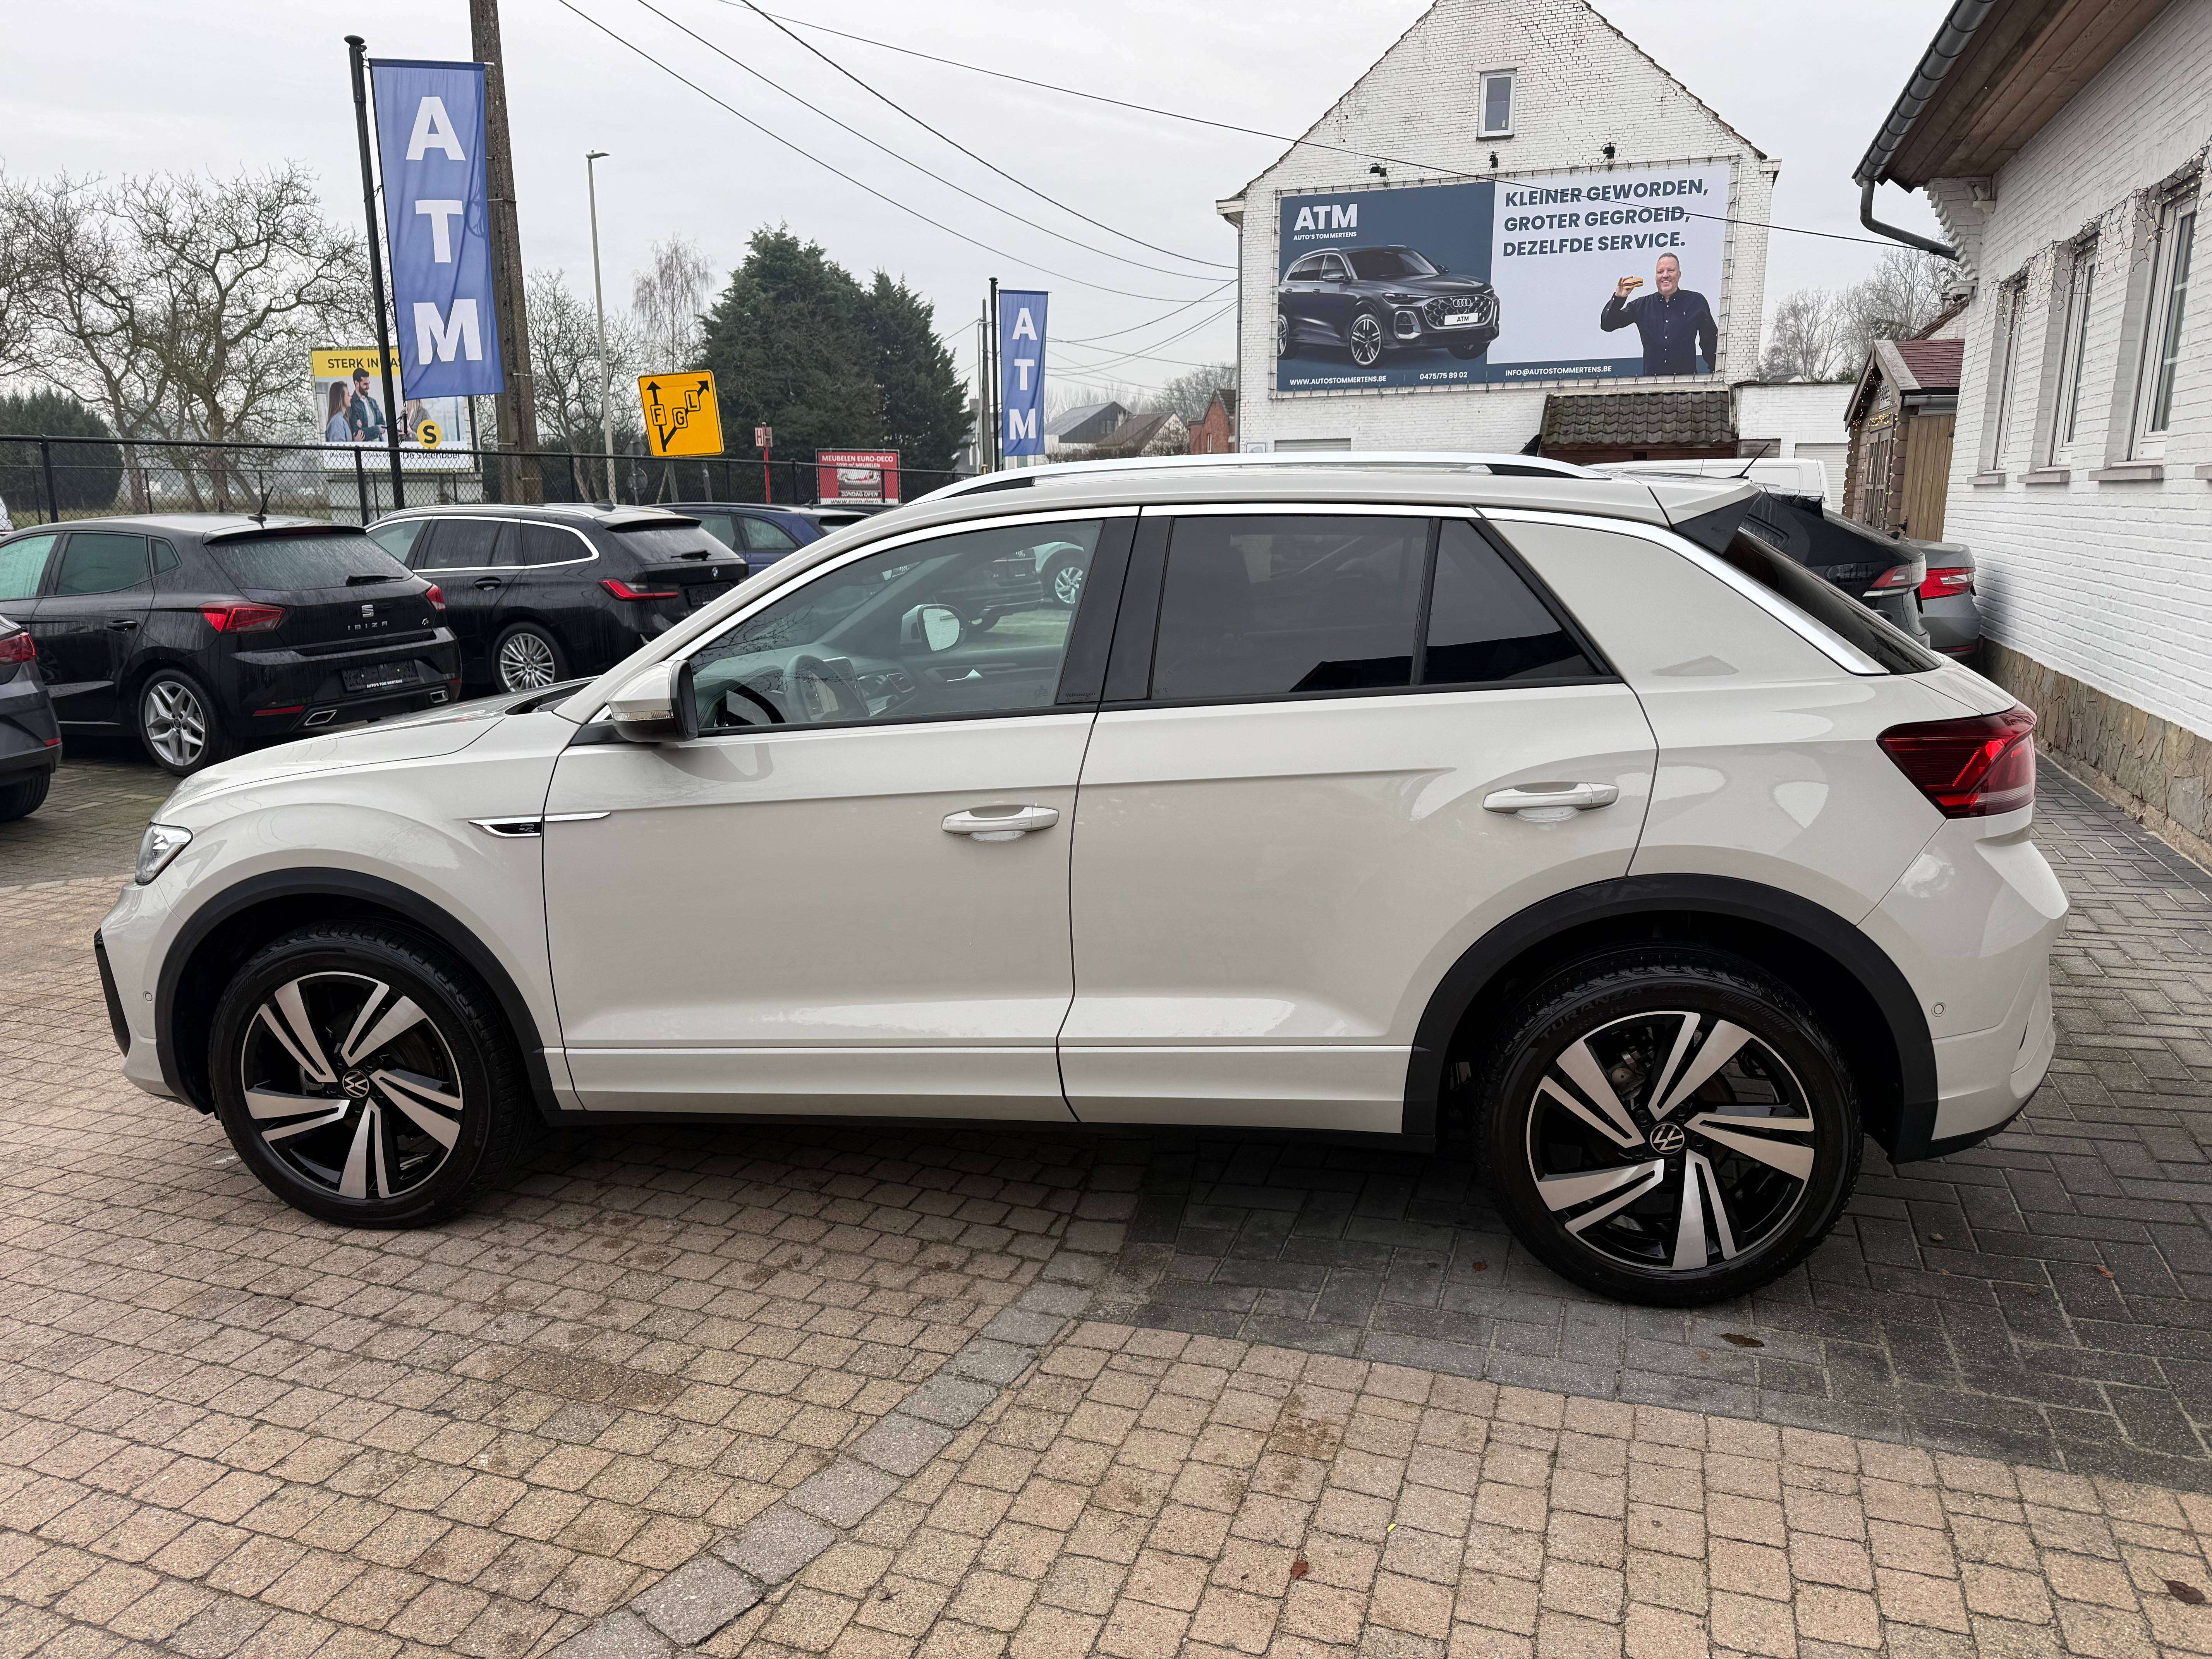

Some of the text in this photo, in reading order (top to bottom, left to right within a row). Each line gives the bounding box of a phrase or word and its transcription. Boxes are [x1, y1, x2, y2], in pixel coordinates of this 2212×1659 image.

[1505, 179, 1708, 207] KLEINER GEWORDEN,
[1293, 204, 1357, 231] ATM
[1504, 206, 1690, 232] GROTER GEGROEID,
[405, 96, 483, 365] ATM
[1503, 232, 1685, 256] DEZELFDE SERVICE.
[328, 358, 364, 369] STERK
[368, 358, 379, 368] IN
[1505, 366, 1612, 376] INFO@AUTOSTOMMERTENS.BE
[1009, 307, 1038, 440] ATM
[1290, 375, 1386, 385] WWW.AUTOSTOMMERTENS.BE
[688, 394, 697, 408] L
[654, 407, 661, 422] F
[675, 411, 685, 425] G
[423, 425, 436, 444] S
[348, 621, 388, 630] IBIZA
